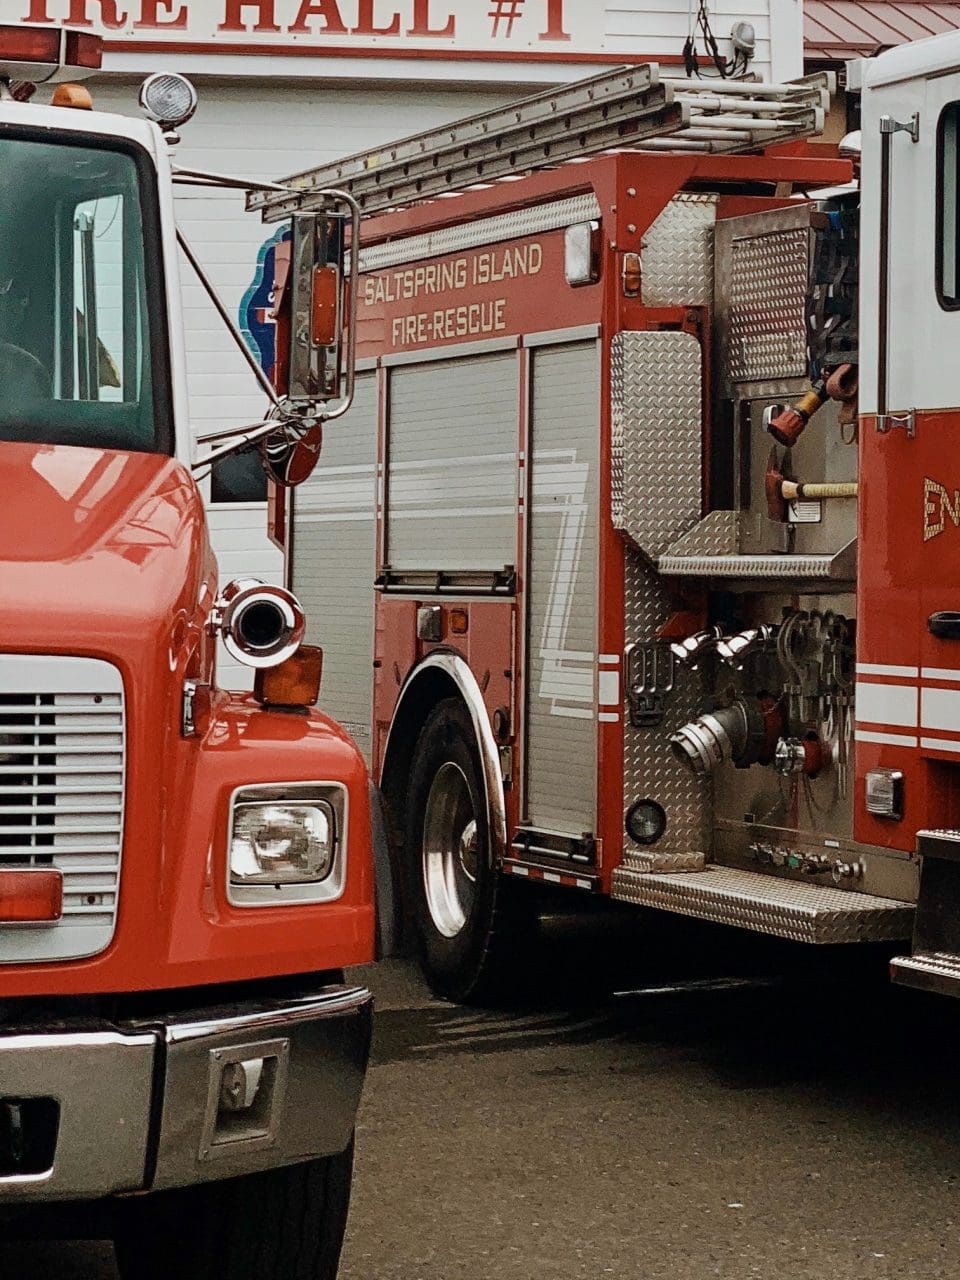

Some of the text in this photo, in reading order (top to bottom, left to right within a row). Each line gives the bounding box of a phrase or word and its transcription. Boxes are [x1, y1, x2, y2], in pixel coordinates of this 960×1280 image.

[364, 243, 542, 306] SALTSPRING ISLAND
[392, 299, 506, 346] FIRE-RESCUE
